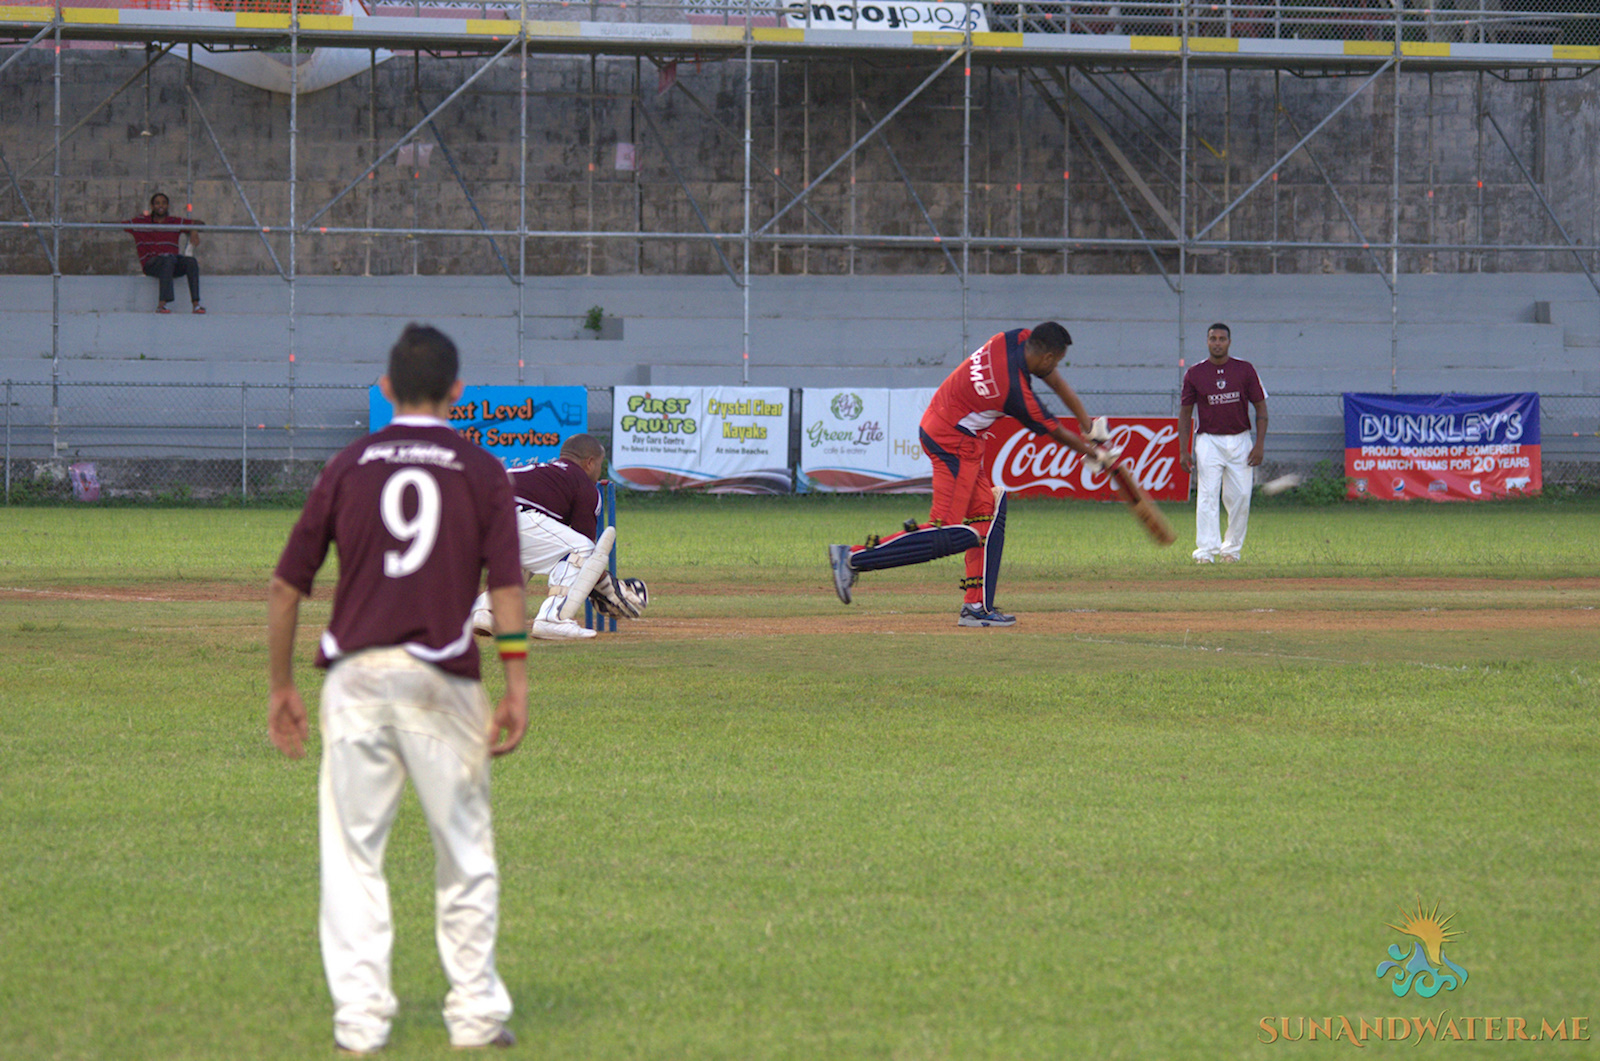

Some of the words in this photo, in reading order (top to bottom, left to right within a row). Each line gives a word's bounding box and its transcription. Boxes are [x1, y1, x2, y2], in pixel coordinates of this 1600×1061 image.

[446, 401, 477, 420] ext
[481, 397, 534, 420] Level
[708, 398, 752, 419] Crystal
[752, 399, 784, 417] Clear
[458, 426, 482, 446] ift
[486, 427, 560, 447] Services
[723, 421, 768, 444] Kayaks
[805, 420, 854, 448] Green
[852, 420, 885, 446] Lite
[1359, 411, 1524, 444] DUNKLEY'S
[632, 435, 645, 445] Day
[646, 435, 662, 445] Care
[663, 436, 685, 445] Centre
[715, 446, 724, 455] At
[724, 447, 740, 455] nine
[741, 447, 769, 456] Beaches
[893, 438, 924, 461] Hig
[1361, 445, 1399, 457] PROUD
[1400, 445, 1449, 458] SPONSOR
[1450, 445, 1465, 456] OF
[1466, 443, 1522, 456] SOMERSET
[992, 423, 1180, 493] CocaCola
[1353, 459, 1376, 471] CUP
[1377, 459, 1414, 471] MATCH
[1415, 459, 1448, 471] TEAMS
[1449, 458, 1471, 471] FOR
[1473, 456, 1495, 473] 20
[1497, 457, 1530, 469] YEARS
[380, 467, 442, 578] 9
